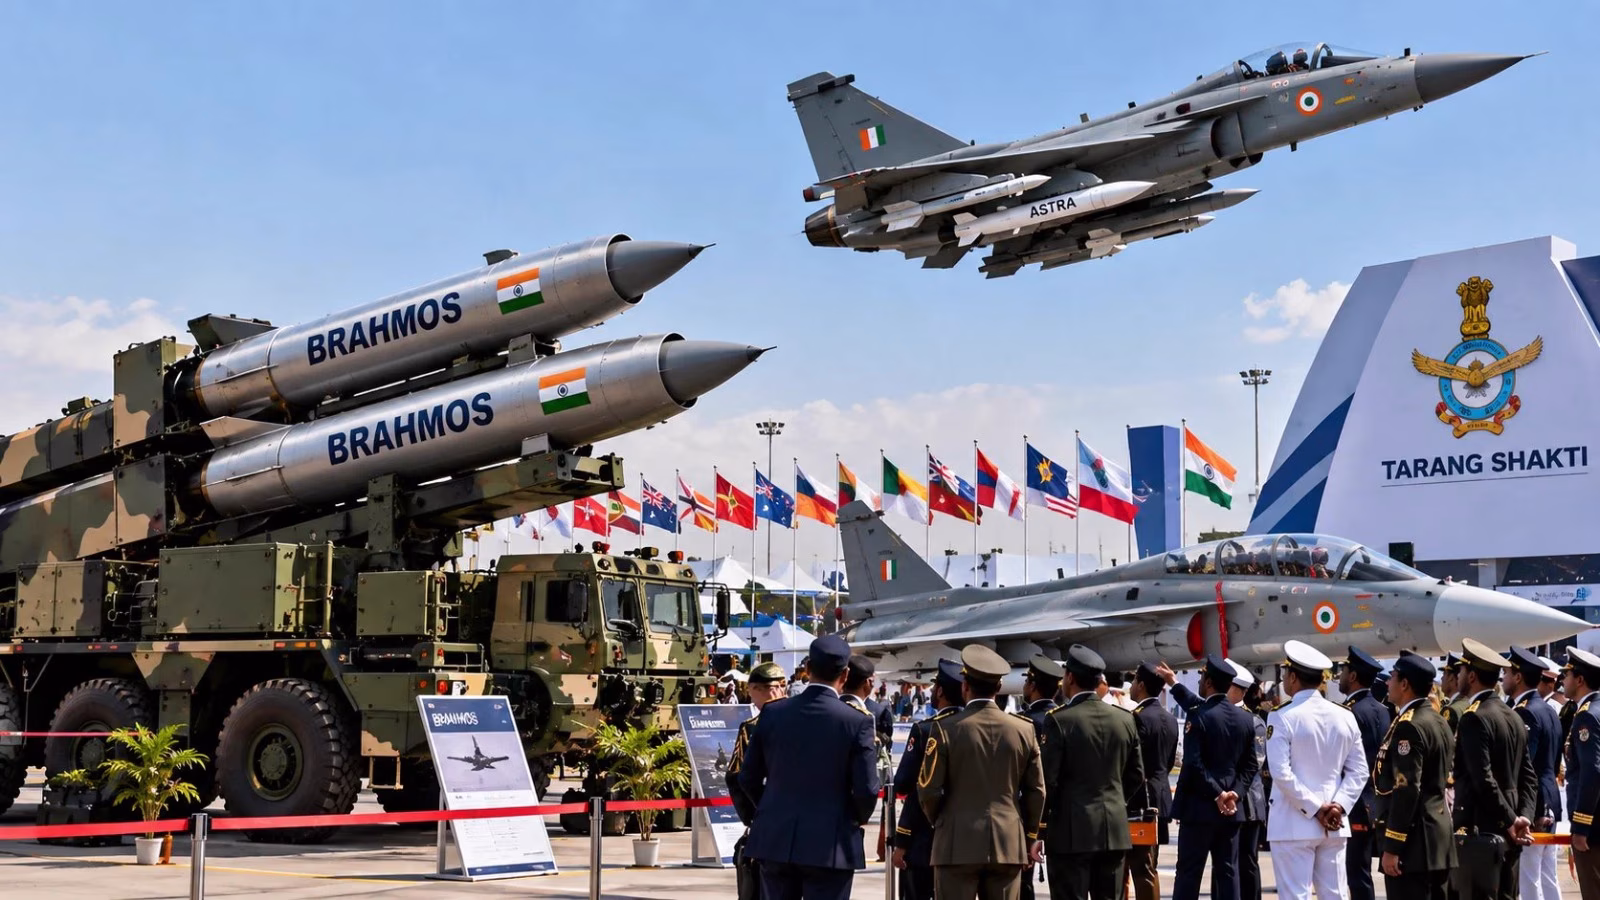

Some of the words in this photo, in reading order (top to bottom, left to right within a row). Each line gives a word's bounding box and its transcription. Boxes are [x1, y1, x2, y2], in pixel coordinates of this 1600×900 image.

[1030, 197, 1076, 218] ASTRA
[307, 291, 462, 365] BRAHMOS
[328, 392, 494, 466] BRAHMOS
[1381, 453, 1483, 480] TARANG
[1491, 446, 1588, 473] SHAKTI
